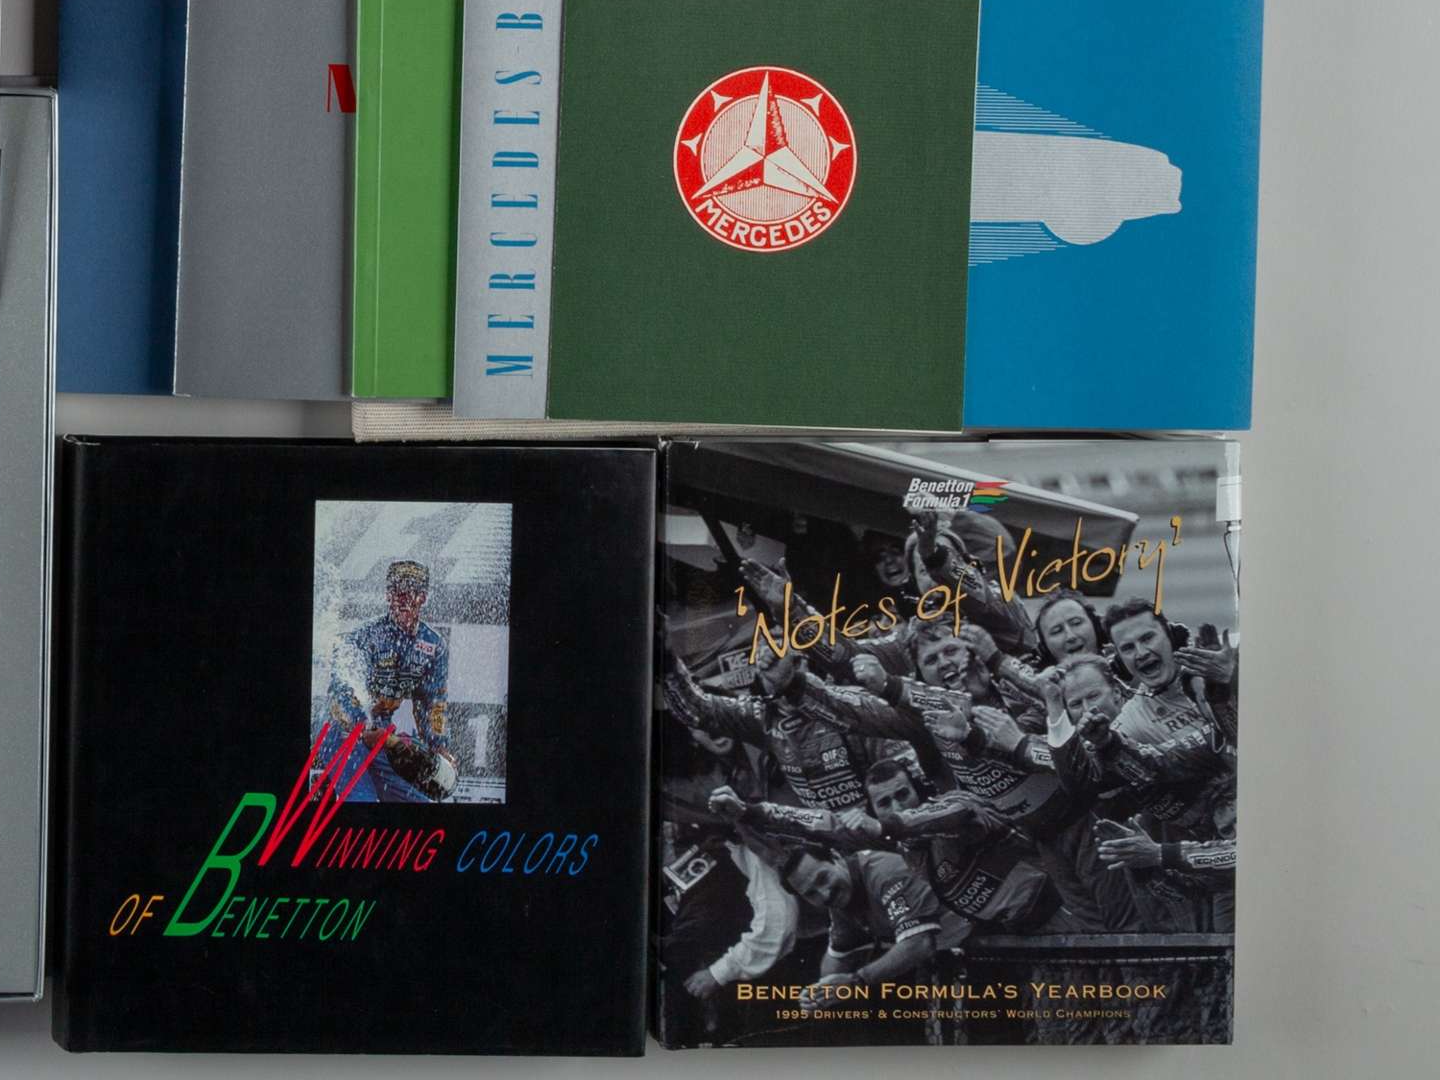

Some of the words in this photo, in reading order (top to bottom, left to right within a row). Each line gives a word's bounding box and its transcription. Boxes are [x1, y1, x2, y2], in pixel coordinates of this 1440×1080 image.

[695, 197, 833, 248] MERCEDES
[908, 477, 974, 493] Benetton
[903, 492, 962, 508] Formula
[258, 723, 446, 873] WINNING
[457, 830, 599, 876] COLORS
[109, 894, 163, 937] OF
[163, 792, 376, 941] BENETTON
[737, 984, 869, 1000] BENETTON
[881, 983, 1018, 999] FORMULA'S
[1030, 983, 1167, 999] YEARBOOK
[776, 1010, 808, 1019] 1995
[878, 1010, 887, 1019] &
[1006, 1010, 1050, 1018] WORLD
[1056, 1009, 1131, 1018] CHAMPIONS
